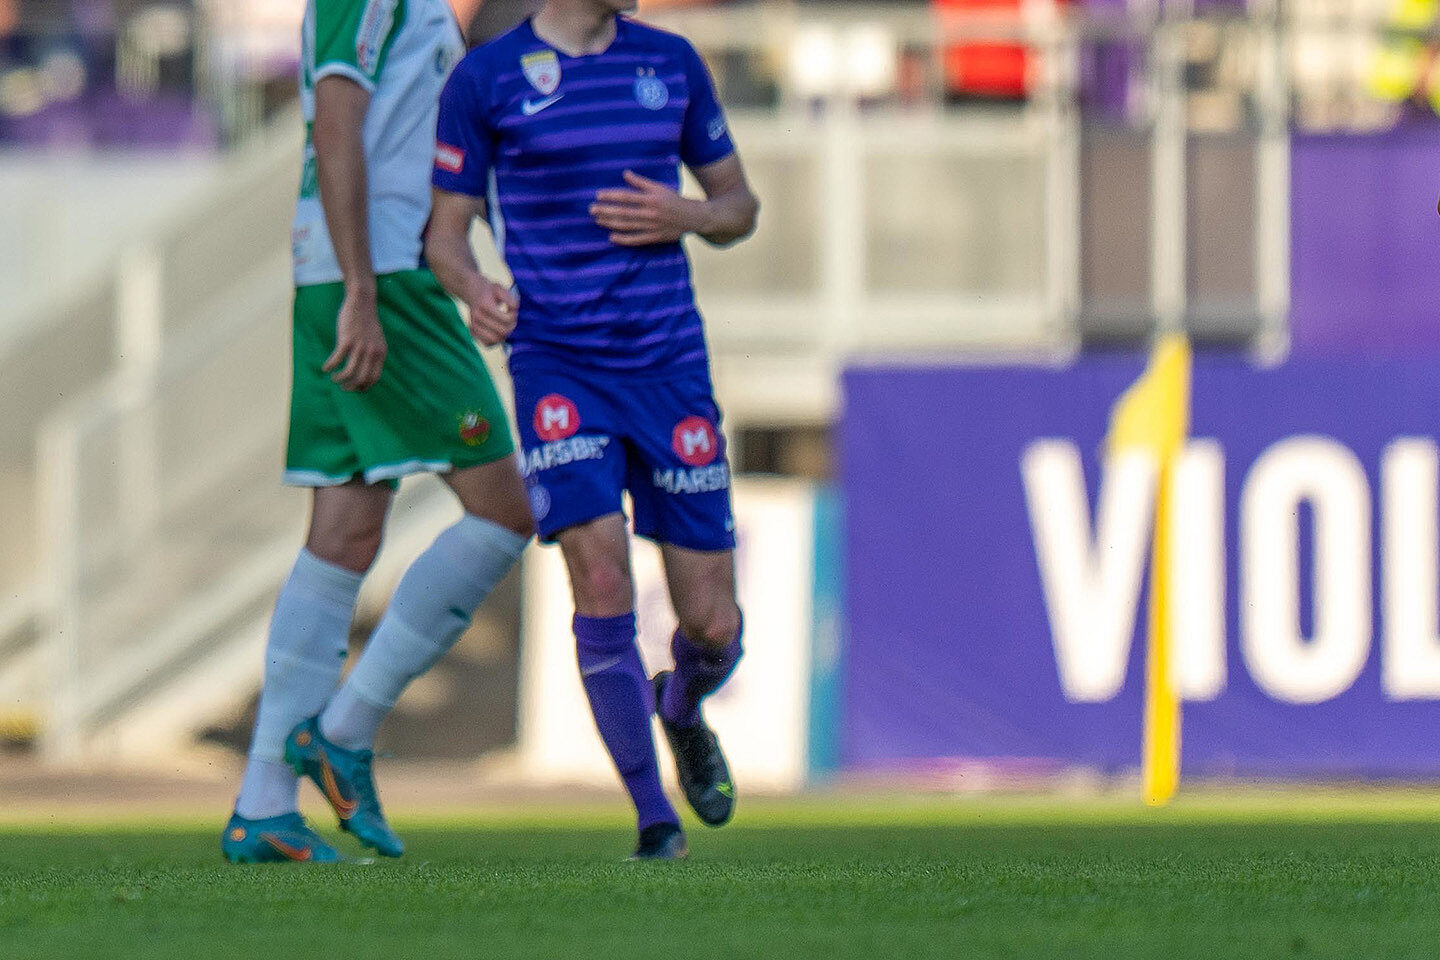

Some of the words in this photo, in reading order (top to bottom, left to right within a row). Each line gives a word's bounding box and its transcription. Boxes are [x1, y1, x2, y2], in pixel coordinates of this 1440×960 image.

[542, 405, 569, 431] M
[681, 426, 711, 456] M
[1020, 435, 1440, 705] VIOL
